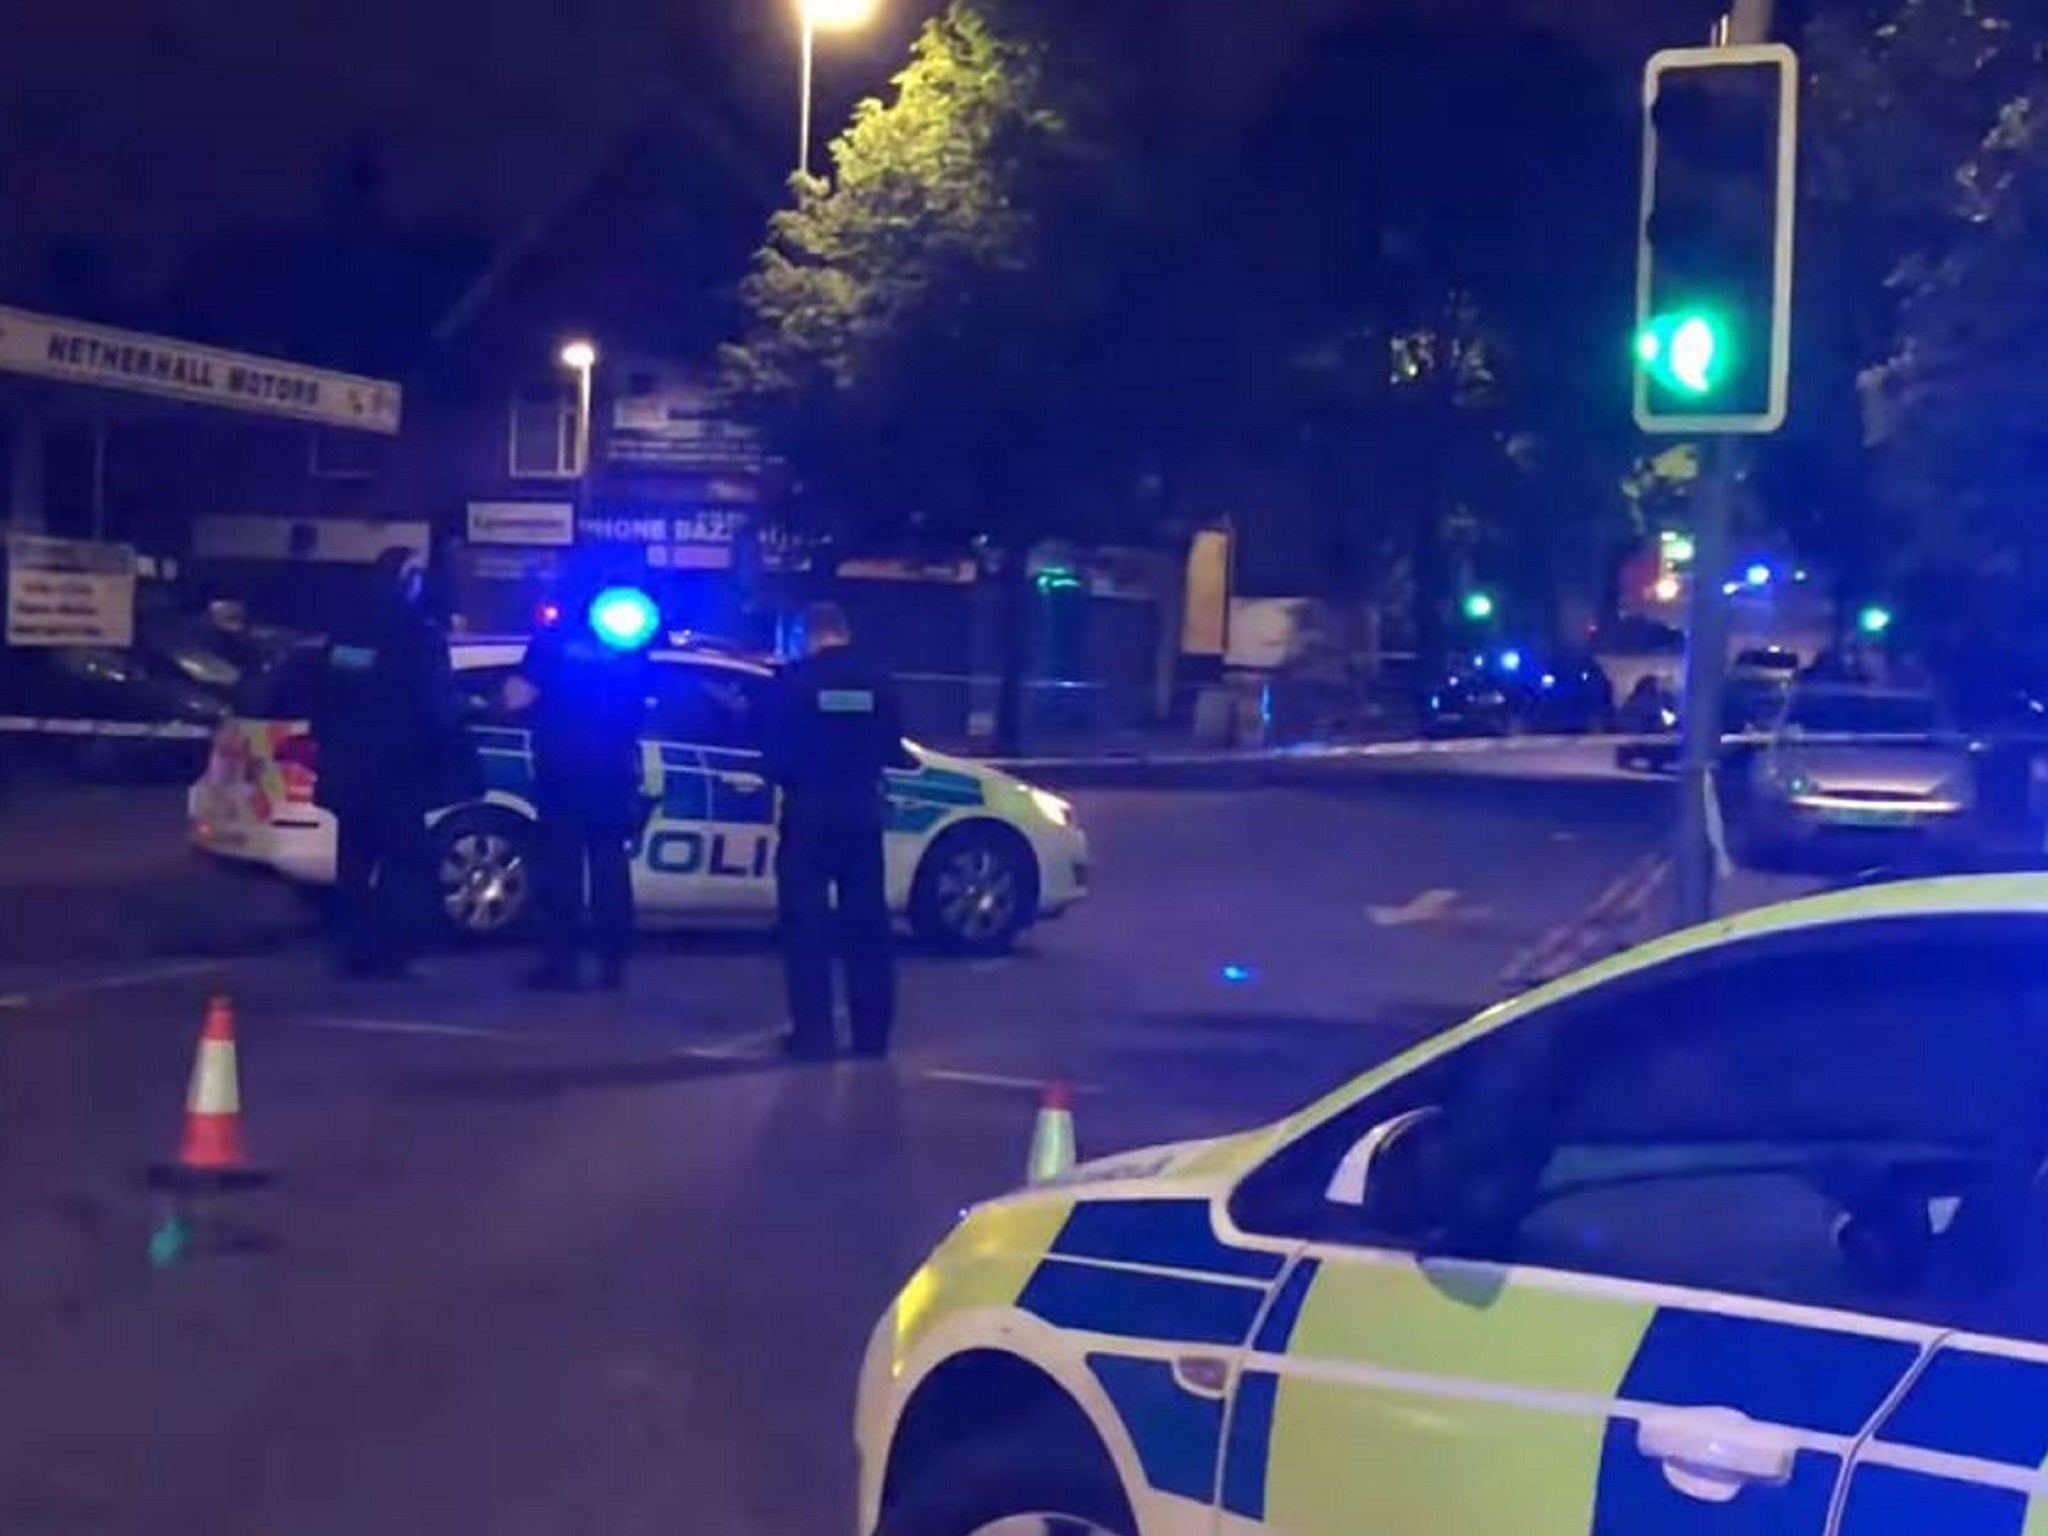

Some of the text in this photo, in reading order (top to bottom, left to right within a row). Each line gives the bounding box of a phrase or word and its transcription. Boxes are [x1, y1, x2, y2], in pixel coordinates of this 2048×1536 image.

[47, 332, 214, 390] NETHERHALL
[229, 366, 320, 406] MOTORS
[646, 830, 768, 878] OLI
